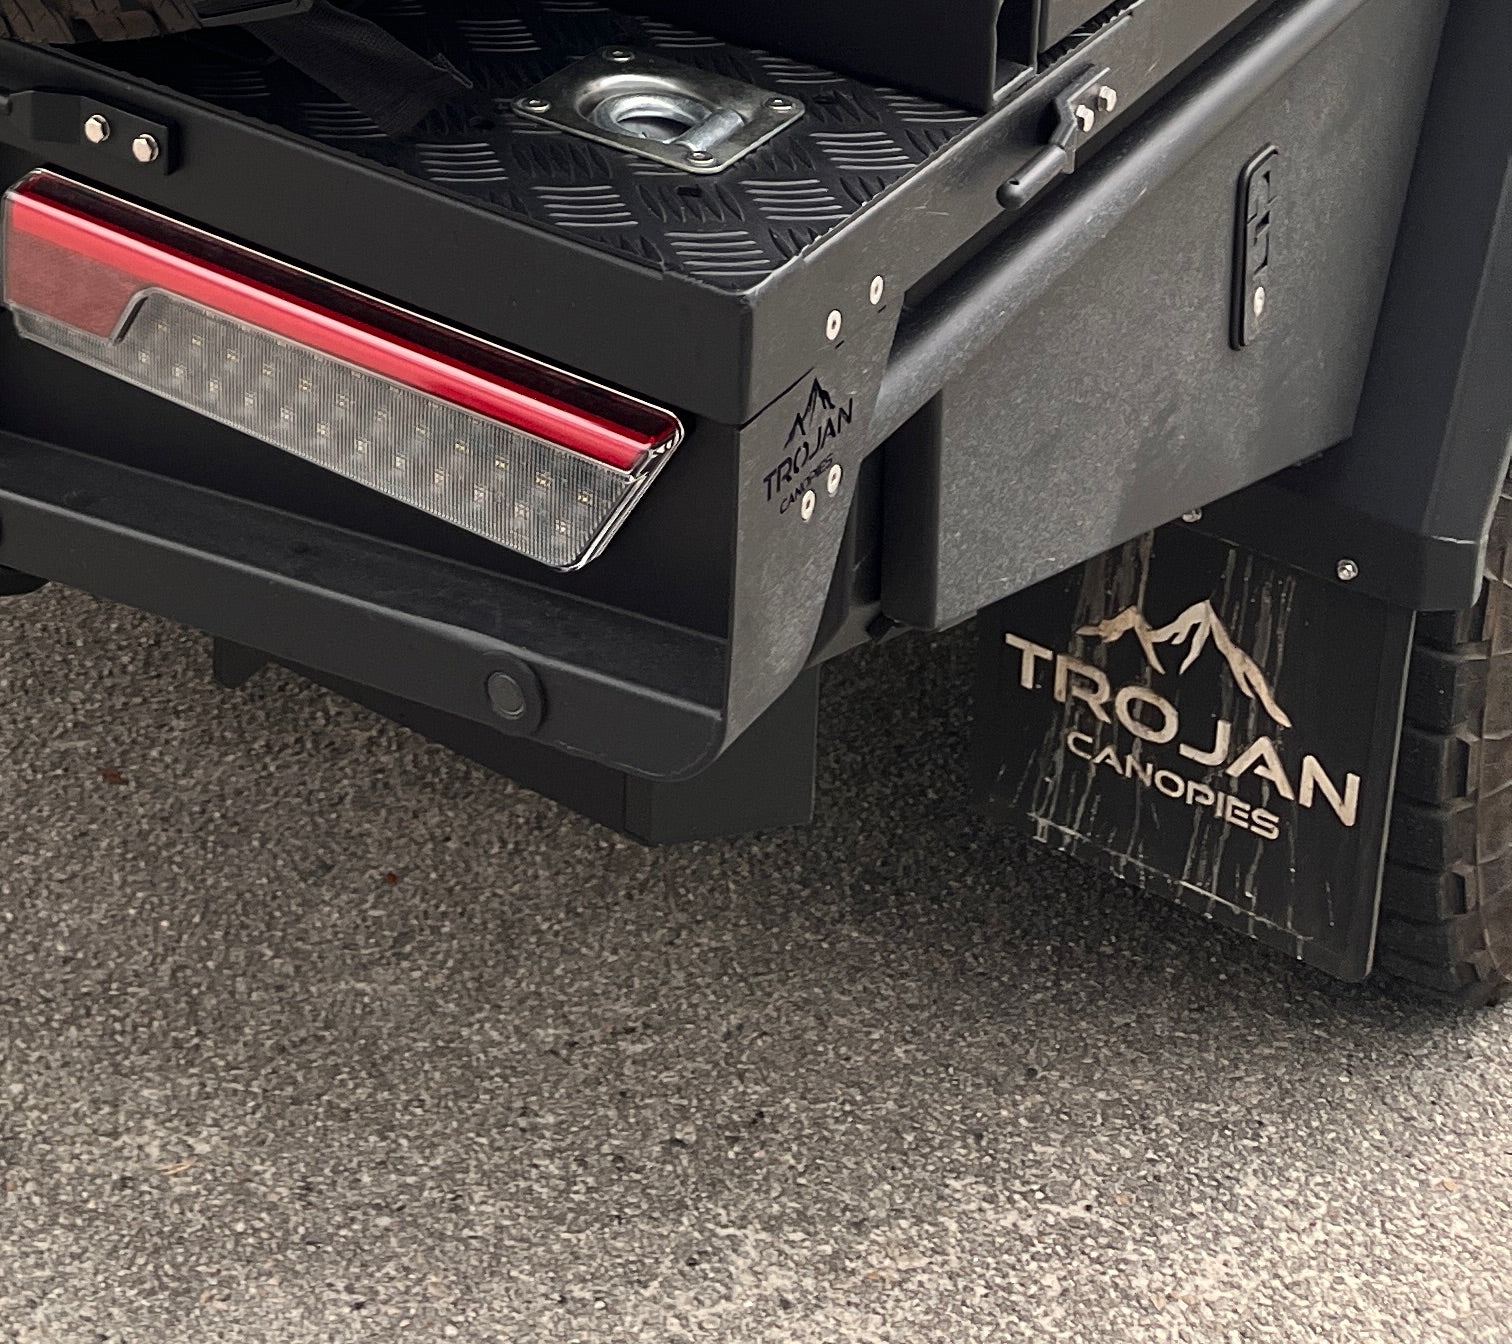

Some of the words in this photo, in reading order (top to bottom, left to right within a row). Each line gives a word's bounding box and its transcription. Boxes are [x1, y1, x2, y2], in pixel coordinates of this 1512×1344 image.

[763, 397, 854, 502] TROJAN
[1005, 633, 1361, 827] TROJAN
[1066, 730, 1281, 841] CANOPIES
